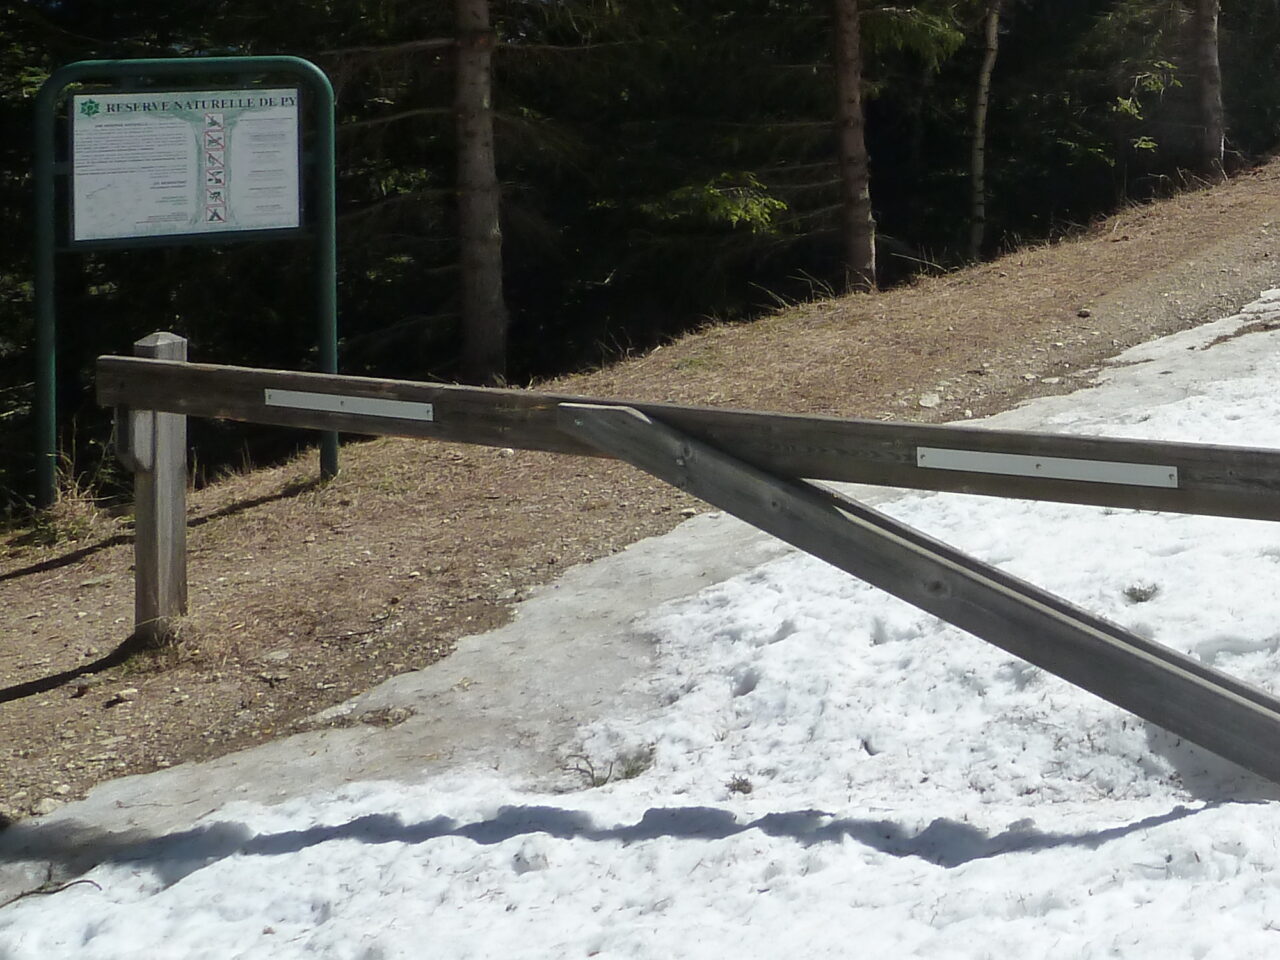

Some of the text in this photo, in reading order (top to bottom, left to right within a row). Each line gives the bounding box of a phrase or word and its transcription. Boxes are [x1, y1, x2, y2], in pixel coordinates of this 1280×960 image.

[107, 100, 170, 113] RESERVE
[173, 97, 255, 112] NATURELLE
[259, 96, 277, 107] DE
